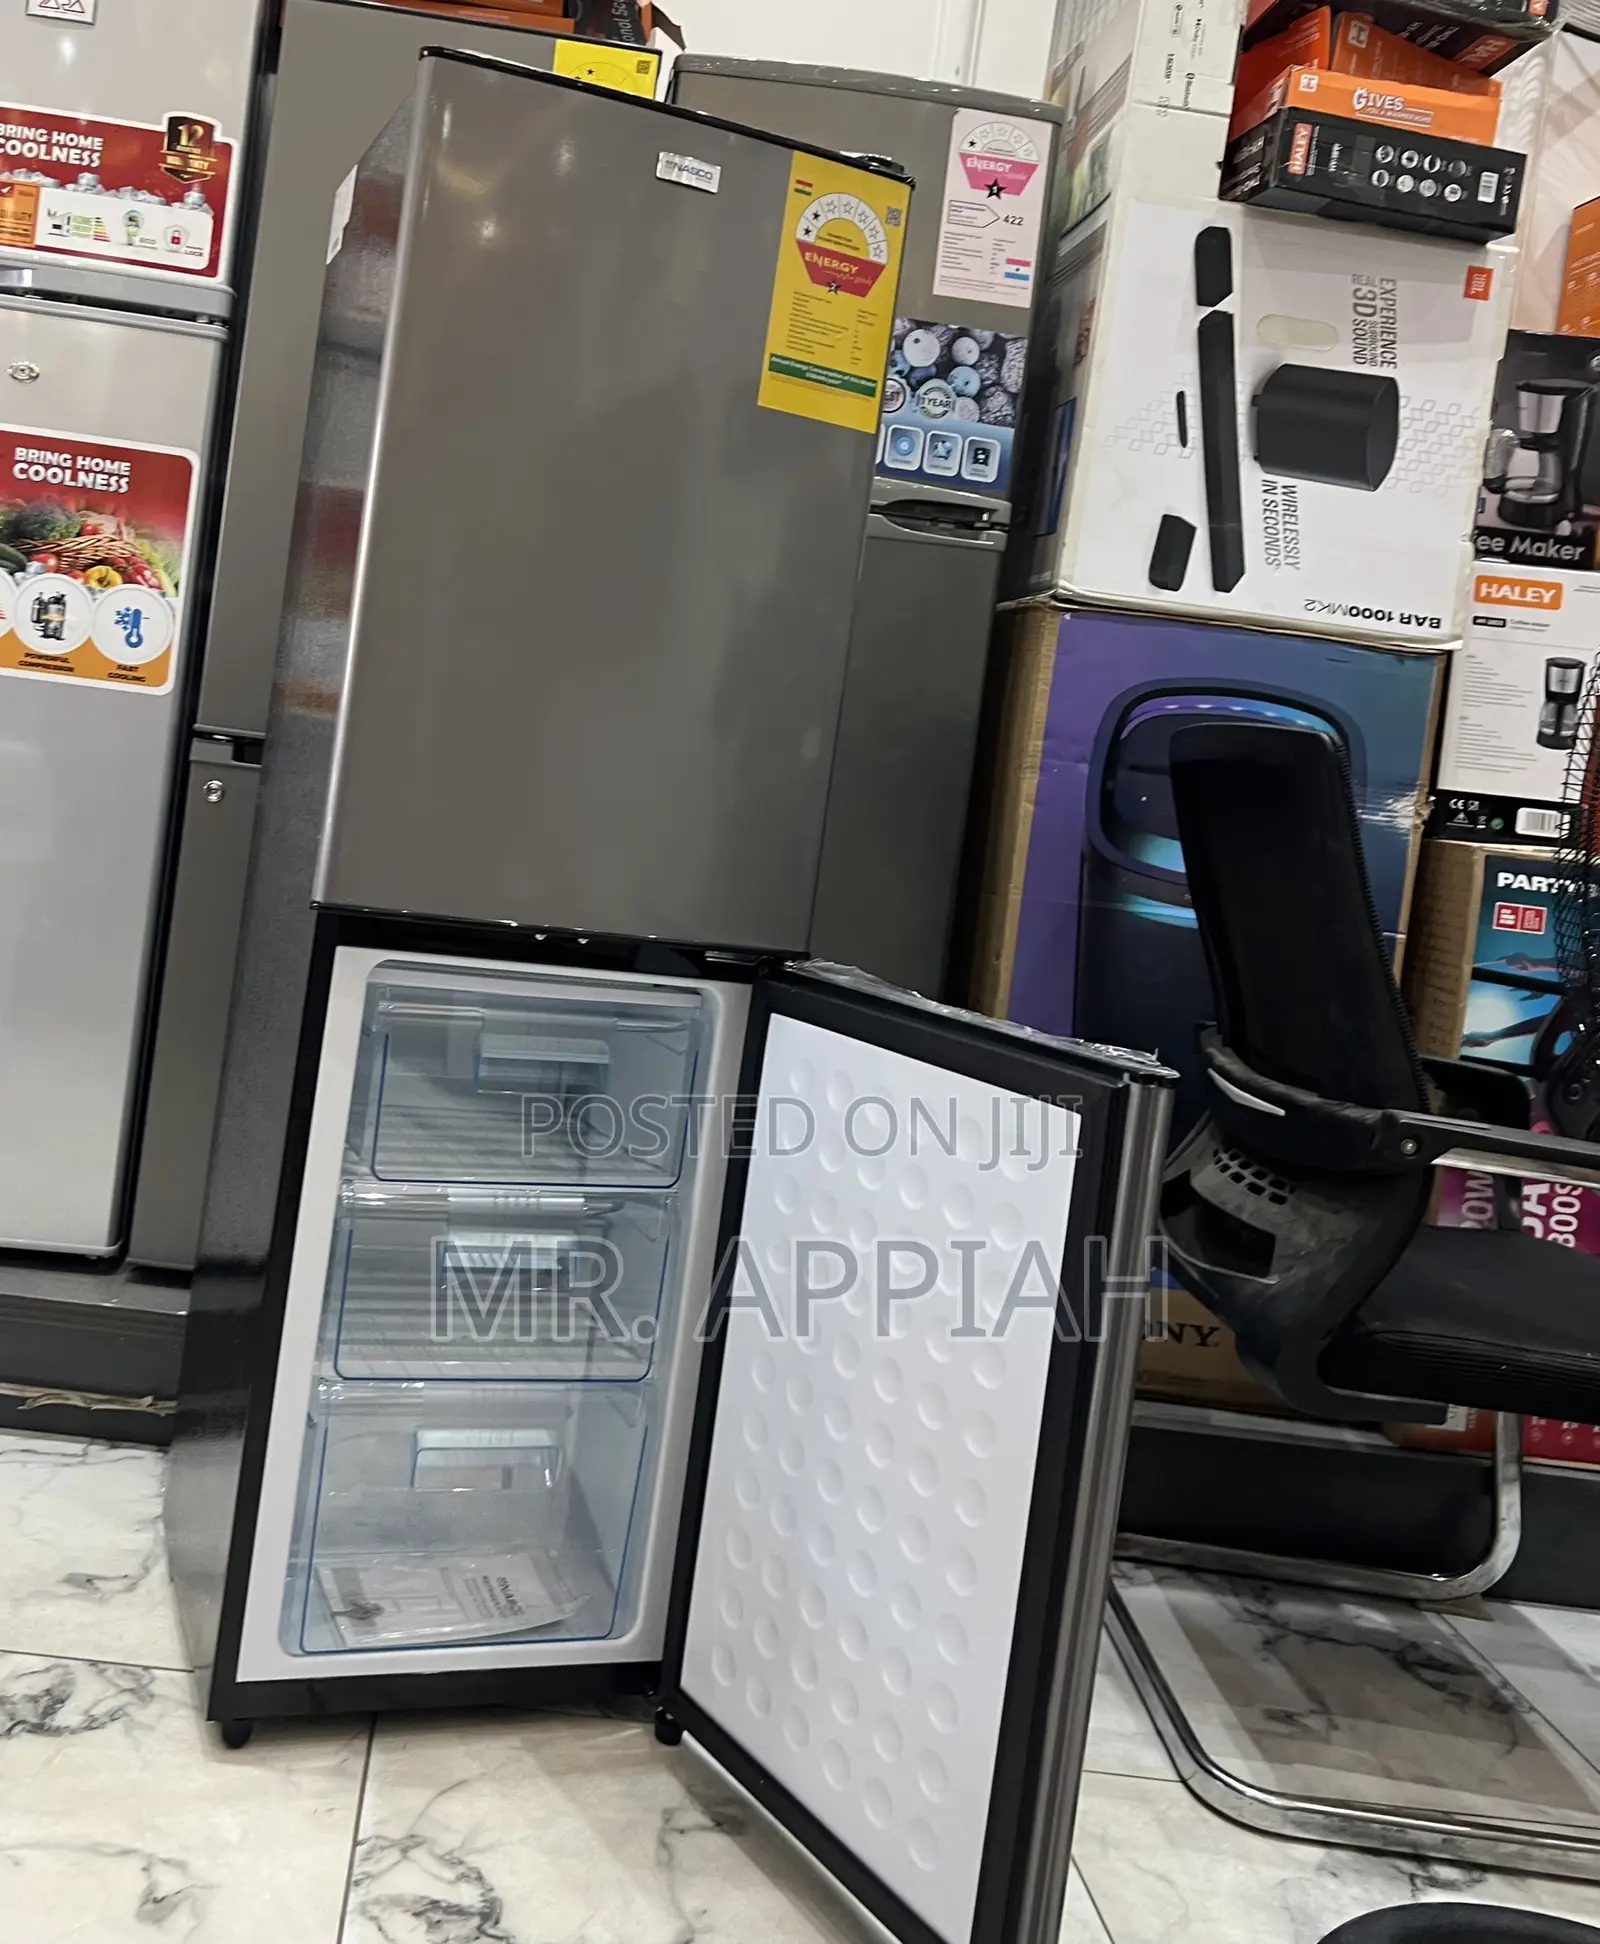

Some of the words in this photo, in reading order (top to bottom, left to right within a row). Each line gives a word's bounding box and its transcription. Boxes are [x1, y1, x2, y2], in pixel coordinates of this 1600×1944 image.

[614, 17, 635, 43] onal
[1352, 86, 1405, 111] GIVES
[52, 131, 104, 151] HOME
[966, 155, 1012, 173] ENERGY
[1001, 214, 1025, 227] 422
[804, 251, 859, 275] ENERGY
[1352, 287, 1377, 318] 3D
[1379, 277, 1398, 370] EXPERIENCE
[1352, 318, 1368, 365] SOUND
[927, 397, 951, 409] YEAR
[14, 447, 73, 468] BRING
[76, 455, 132, 476] HOME
[12, 462, 130, 494] COOLNESS
[1261, 480, 1278, 494] IN
[1263, 499, 1280, 567] SECONDS
[1281, 484, 1300, 570] WIRELESSLY
[1471, 529, 1507, 553] ee
[1509, 531, 1587, 565] Maker
[1479, 582, 1556, 604] HALEY
[1399, 612, 1442, 630] BAR
